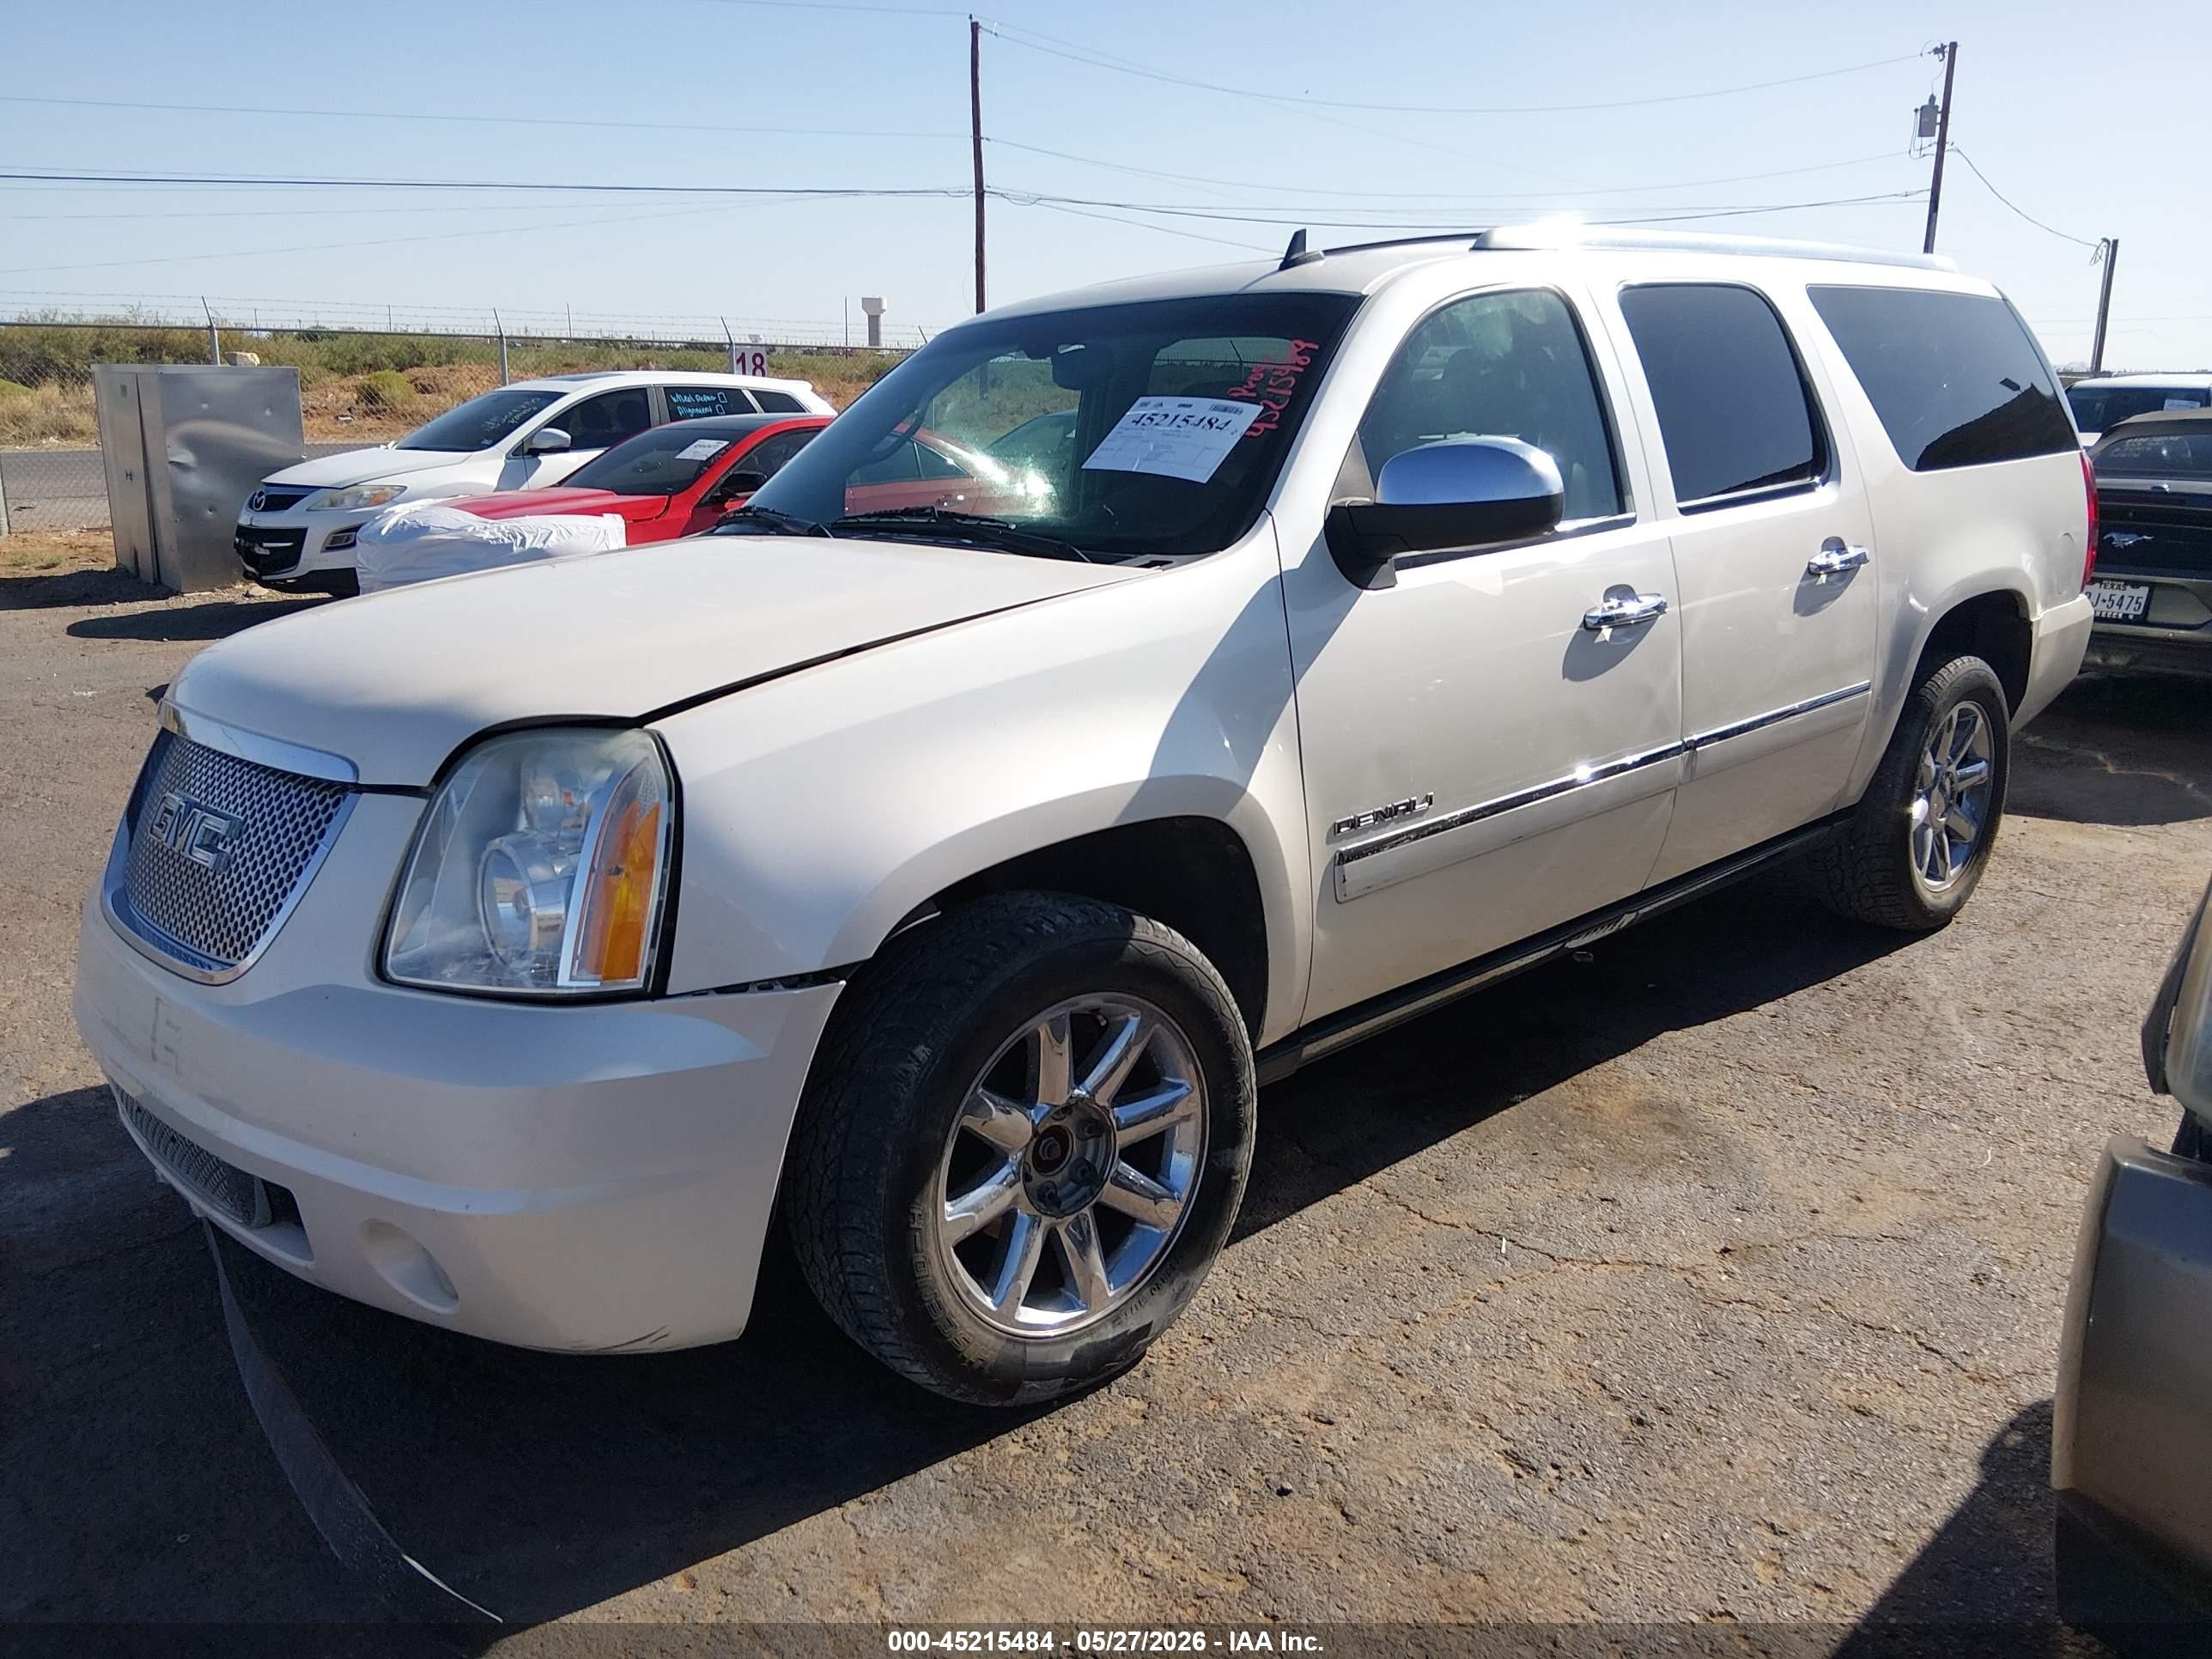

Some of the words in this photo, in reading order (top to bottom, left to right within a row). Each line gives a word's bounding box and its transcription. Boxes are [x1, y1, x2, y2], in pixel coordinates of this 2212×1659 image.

[737, 353, 766, 377] 18
[1132, 413, 1232, 431] 45215484
[149, 792, 240, 870] GMC
[1333, 792, 1434, 836] DENALI
